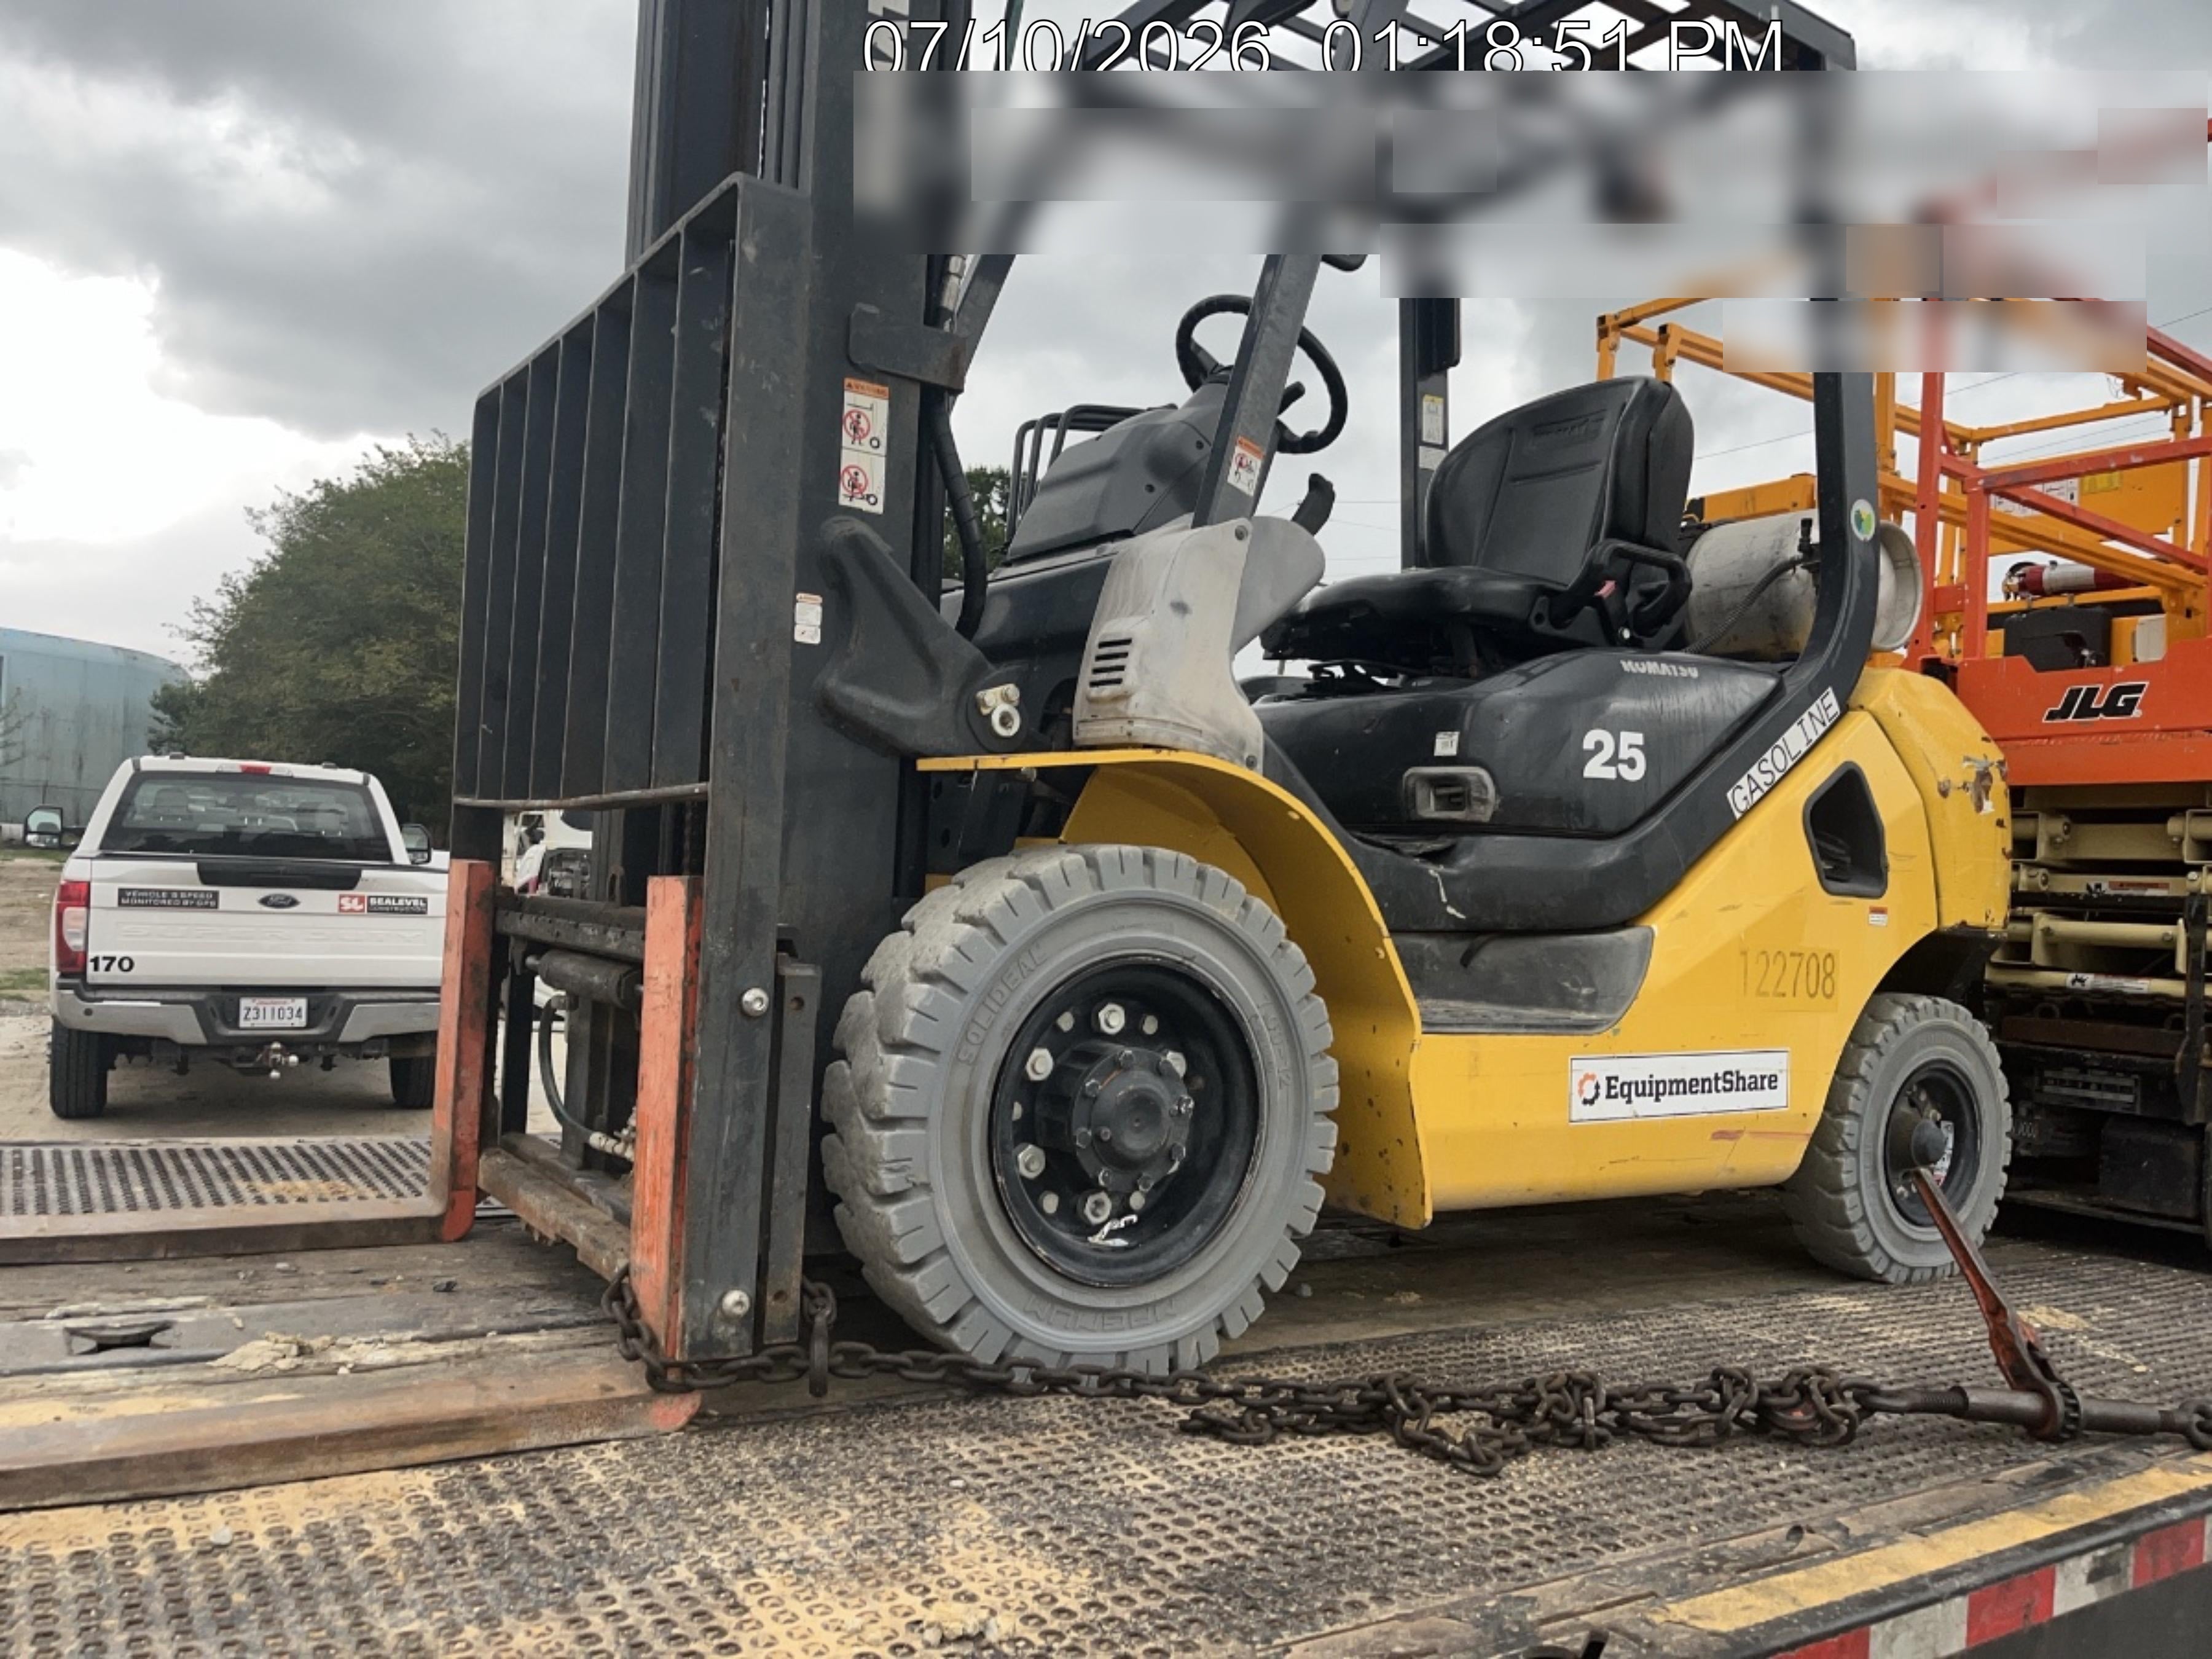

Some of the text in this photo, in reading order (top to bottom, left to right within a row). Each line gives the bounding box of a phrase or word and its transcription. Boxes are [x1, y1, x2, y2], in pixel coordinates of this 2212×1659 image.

[2042, 681, 2149, 723] JLG
[1582, 728, 1647, 782] 25
[1728, 689, 1840, 815] GASOLINE
[369, 896, 427, 907] SEALEVEL
[89, 955, 135, 973] 170
[1739, 950, 1836, 1000] 122708
[243, 1005, 304, 1022] Z311034
[957, 943, 1048, 1064] SOLIDEAL
[1604, 1070, 1778, 1104] EquipmentShare
